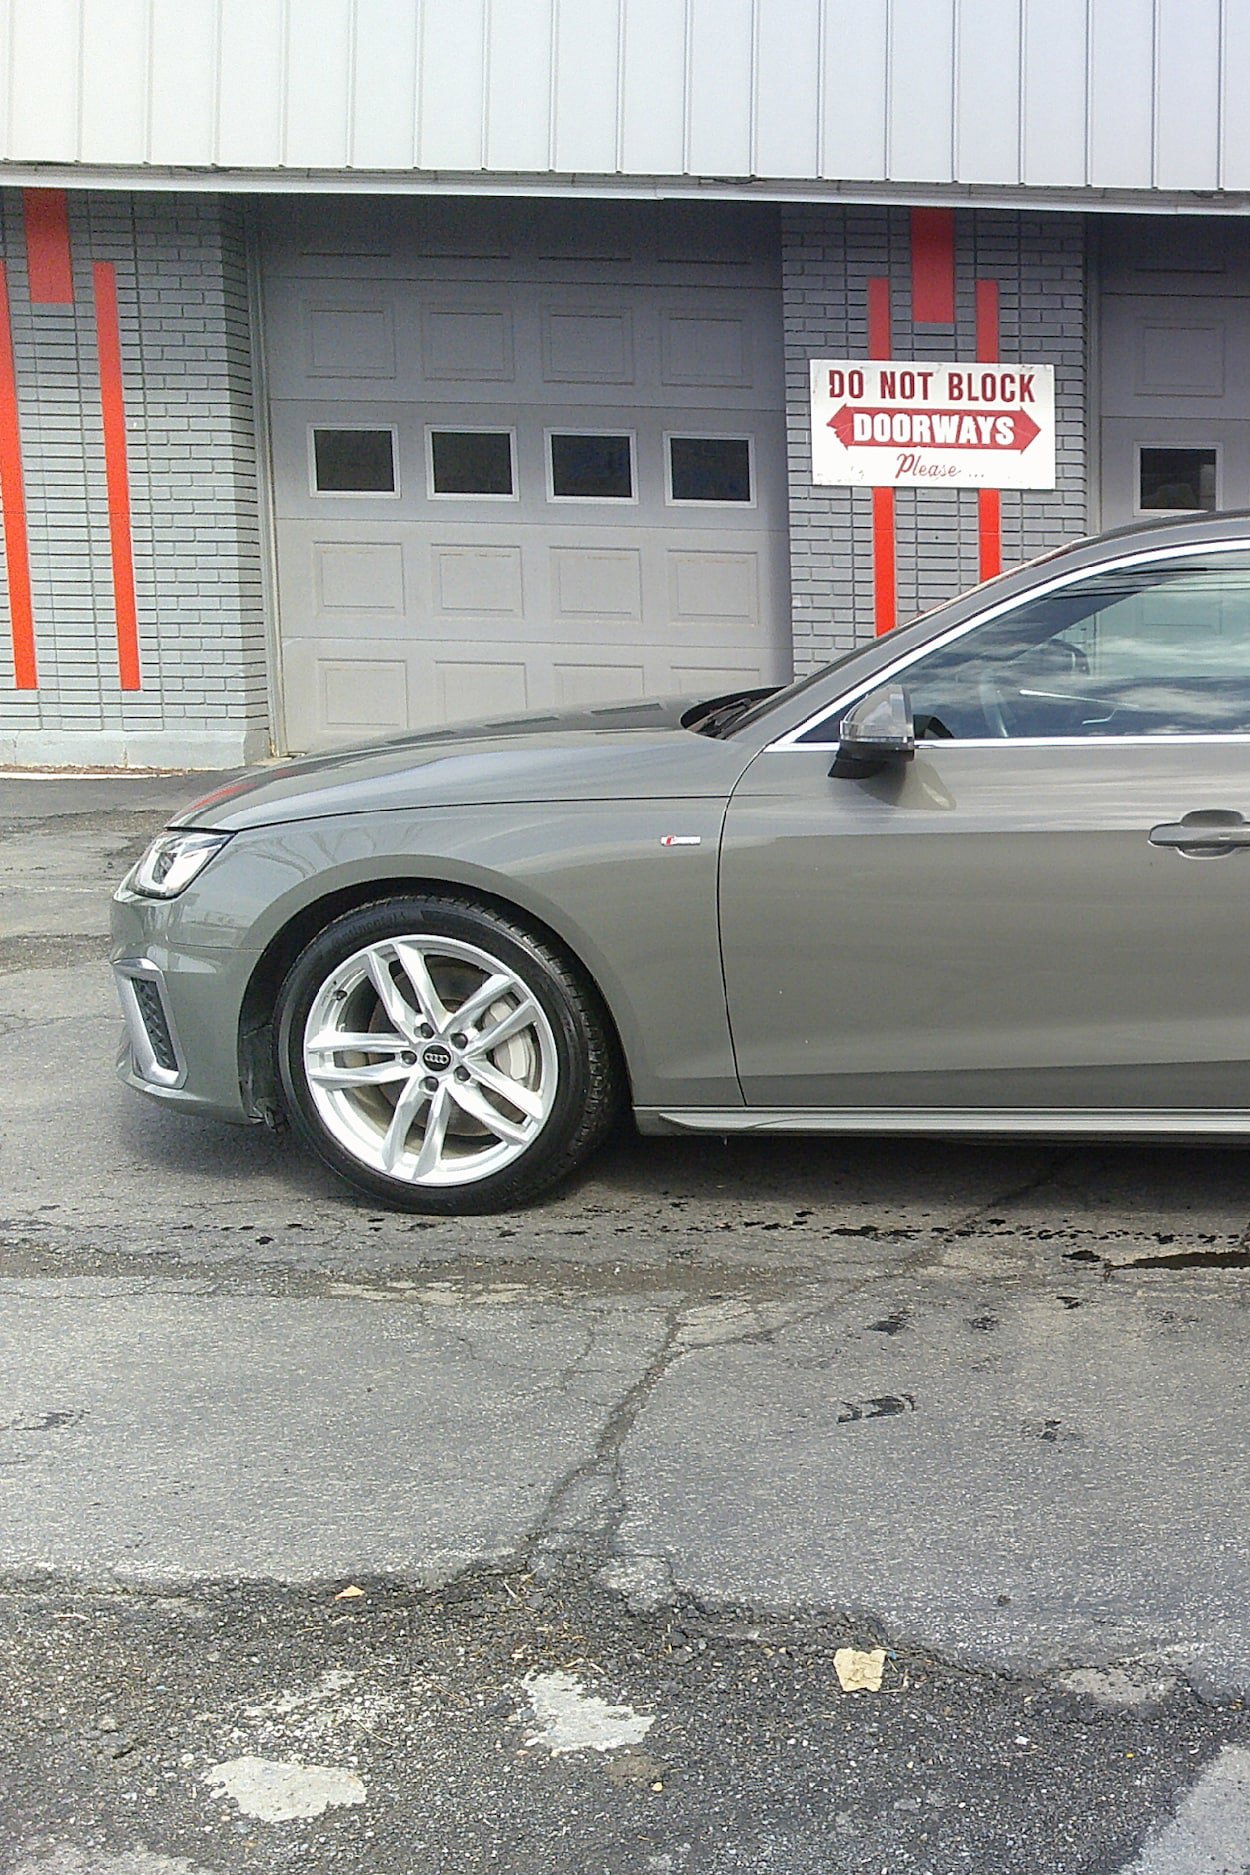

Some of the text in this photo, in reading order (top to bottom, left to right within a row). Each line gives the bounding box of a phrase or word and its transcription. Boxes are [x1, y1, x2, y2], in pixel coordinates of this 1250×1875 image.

[829, 369, 1036, 403] DO NOT BLOCK
[853, 412, 1015, 445] DOORWAYS
[895, 453, 962, 479] Please
